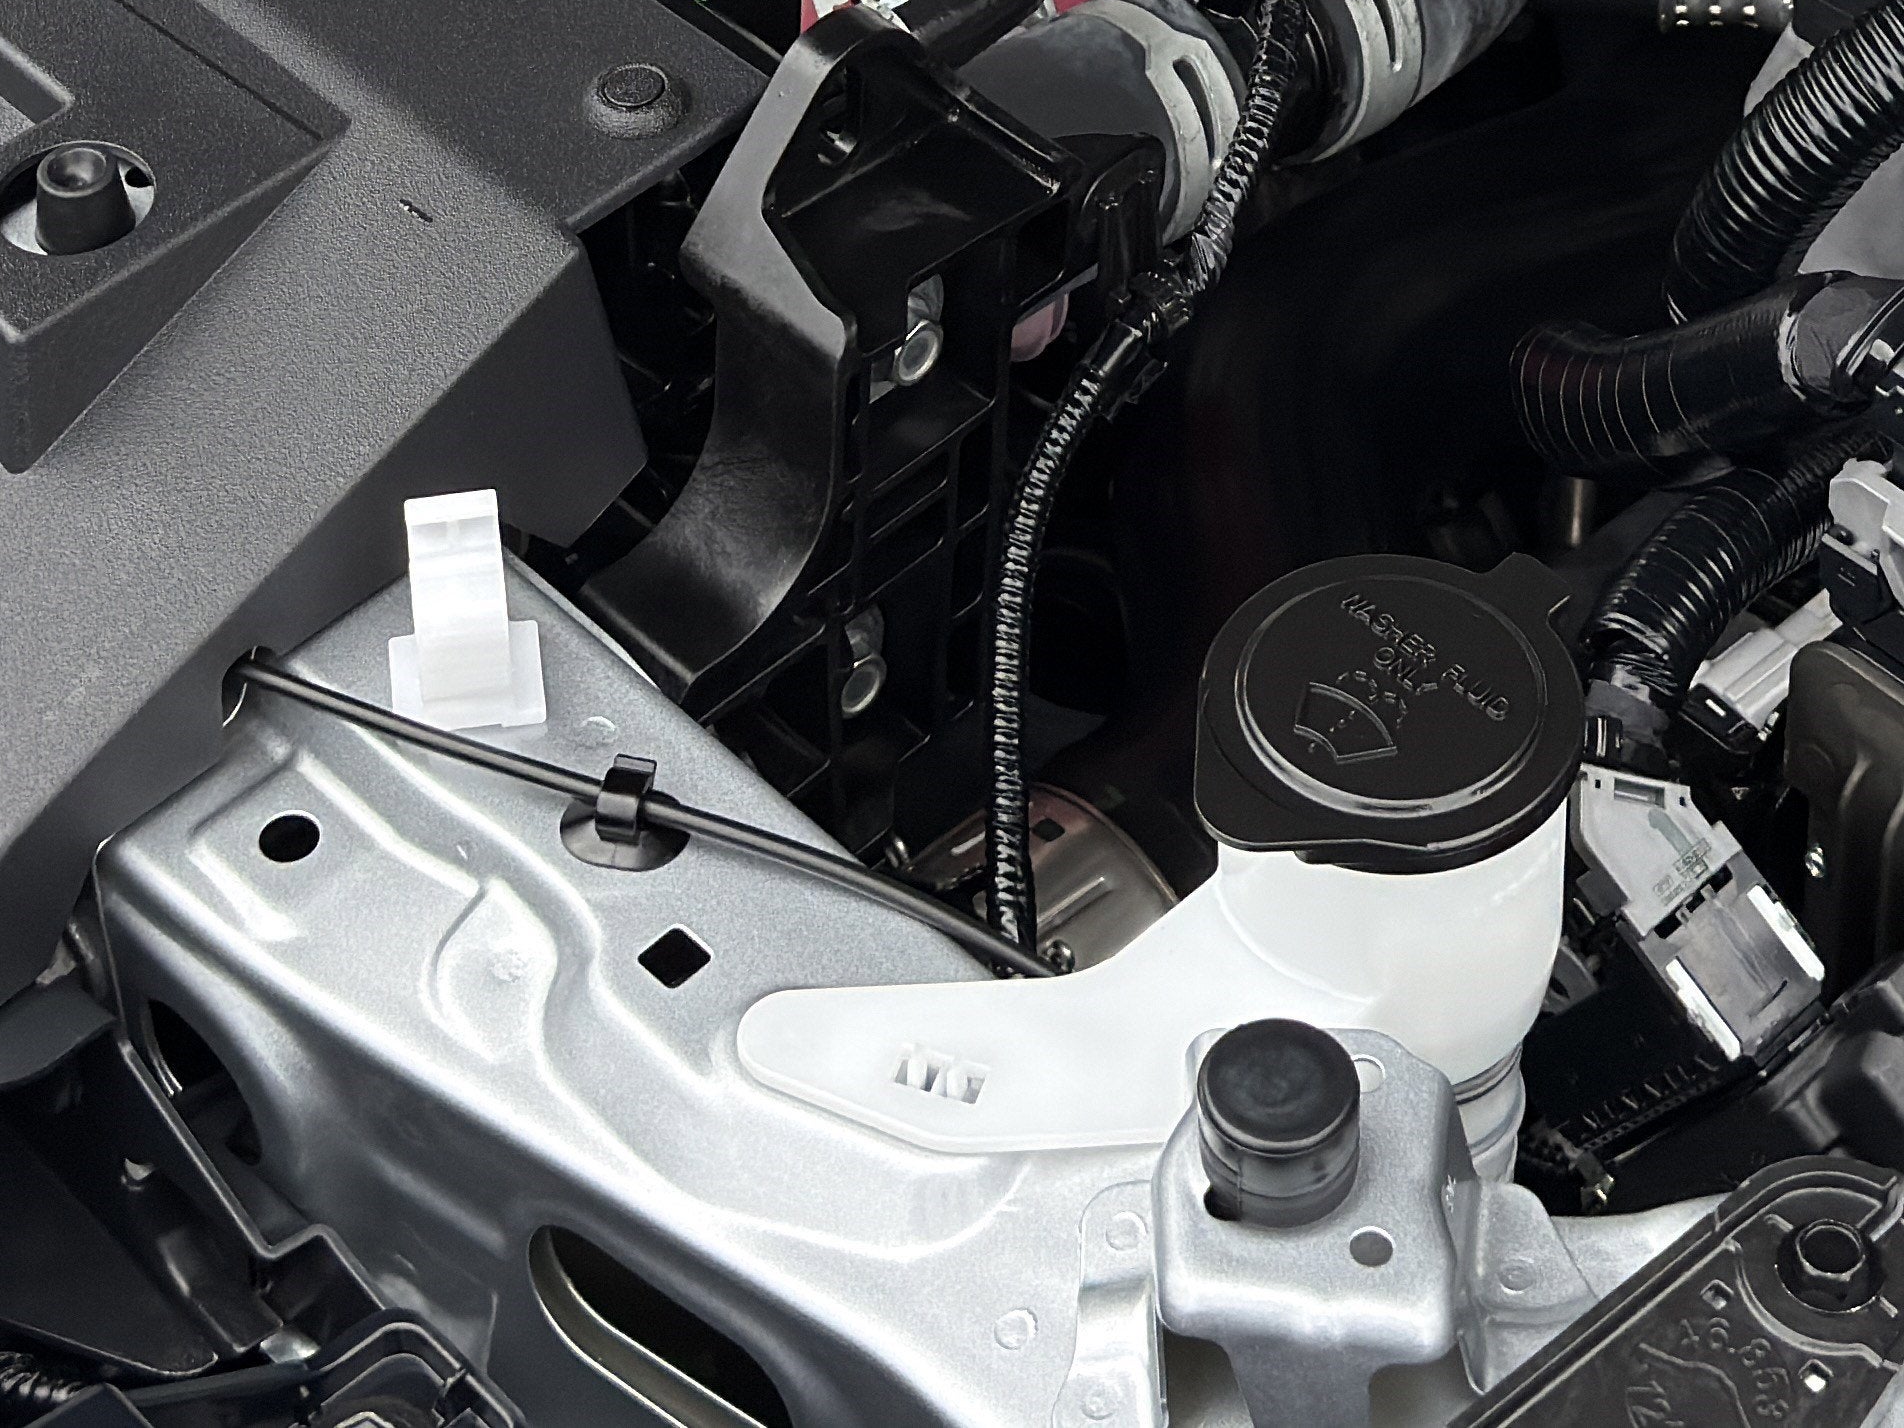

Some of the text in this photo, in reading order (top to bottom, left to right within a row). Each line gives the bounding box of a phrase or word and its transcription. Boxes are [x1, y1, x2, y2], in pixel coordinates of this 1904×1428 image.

[1339, 594, 1510, 722] WASHER FLUID
[1372, 646, 1439, 696] ONLY
